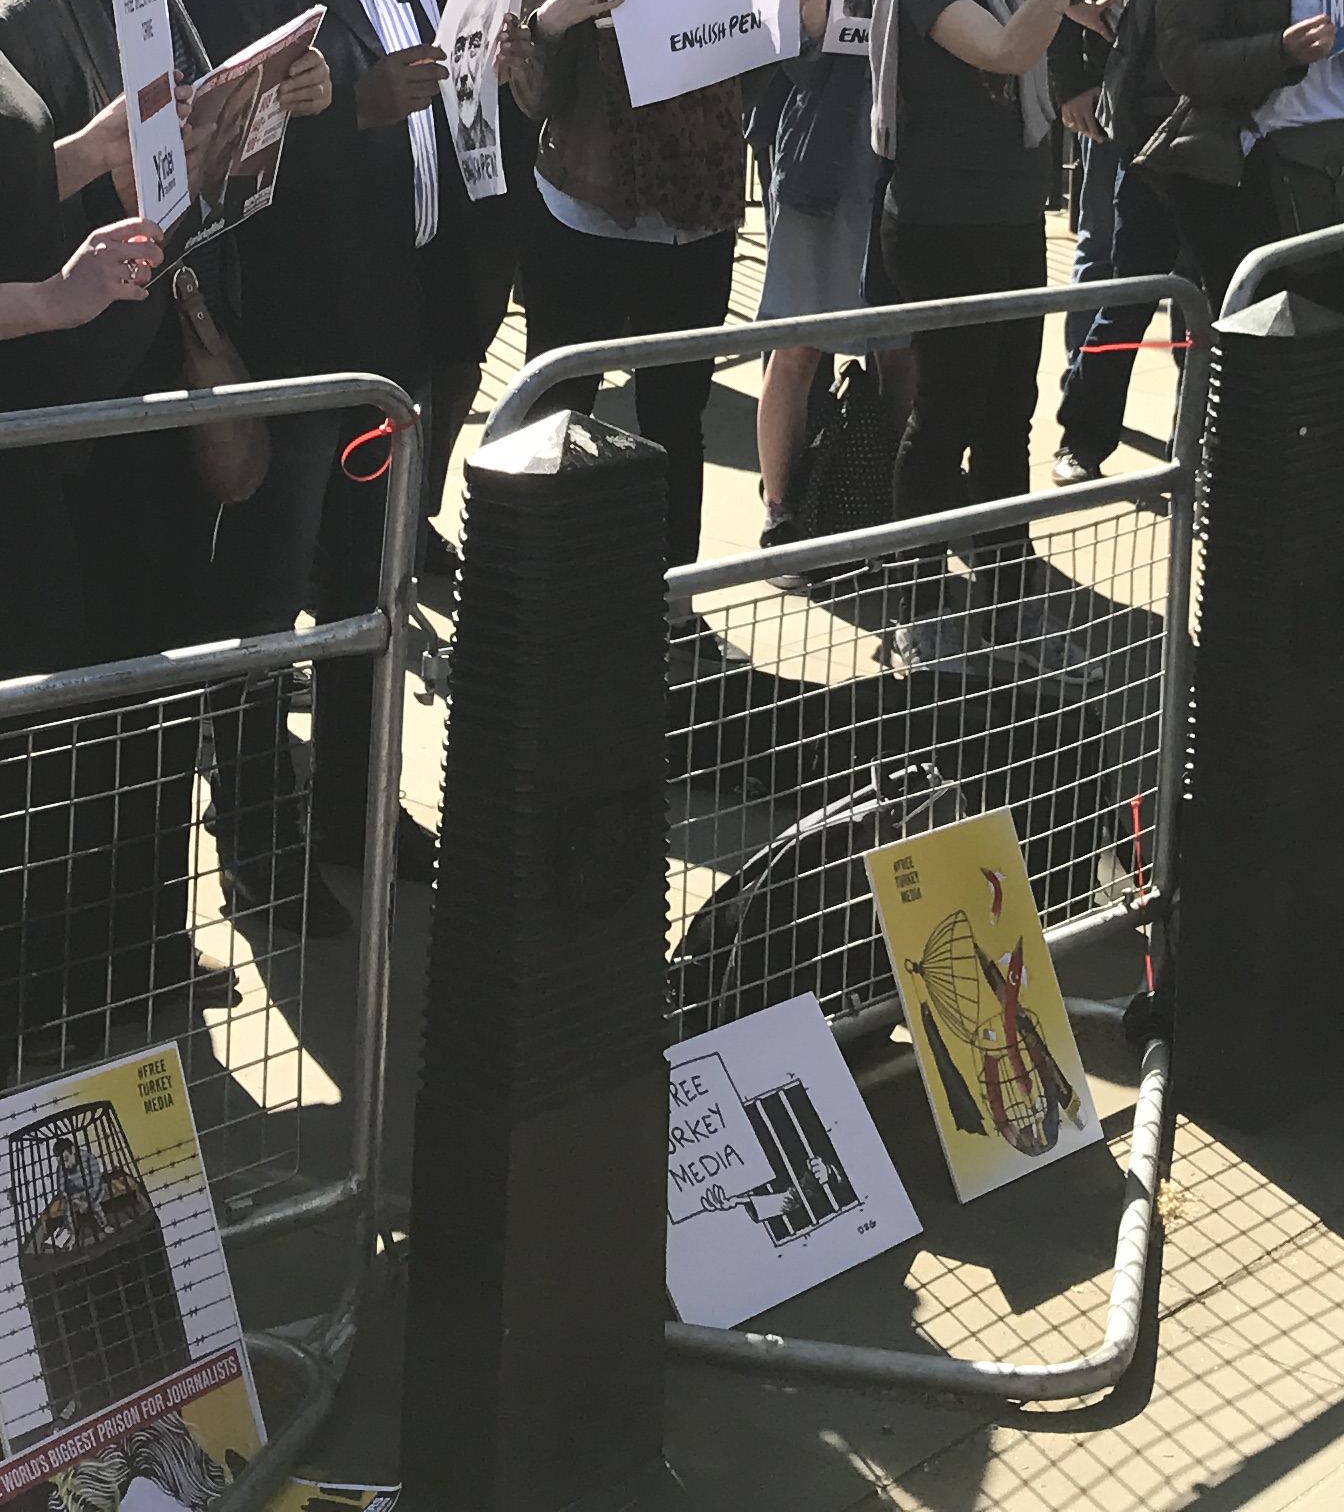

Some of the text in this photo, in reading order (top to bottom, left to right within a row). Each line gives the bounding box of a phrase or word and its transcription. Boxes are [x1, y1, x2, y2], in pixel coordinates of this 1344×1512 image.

[670, 9, 762, 52] ENGLISH PEN
[137, 1059, 166, 1080] #FREE
[137, 1075, 172, 1097] TURKEY
[668, 1075, 709, 1107] REE
[143, 1093, 174, 1114] MEDIA
[668, 1144, 745, 1192] MEDIA
[1, 1458, 49, 1492] WORLD'S
[48, 1436, 98, 1470] BIGGEST
[97, 1410, 141, 1442] PRISON
[141, 1395, 164, 1419] FOR
[165, 1355, 238, 1408] JOURNALISTS
